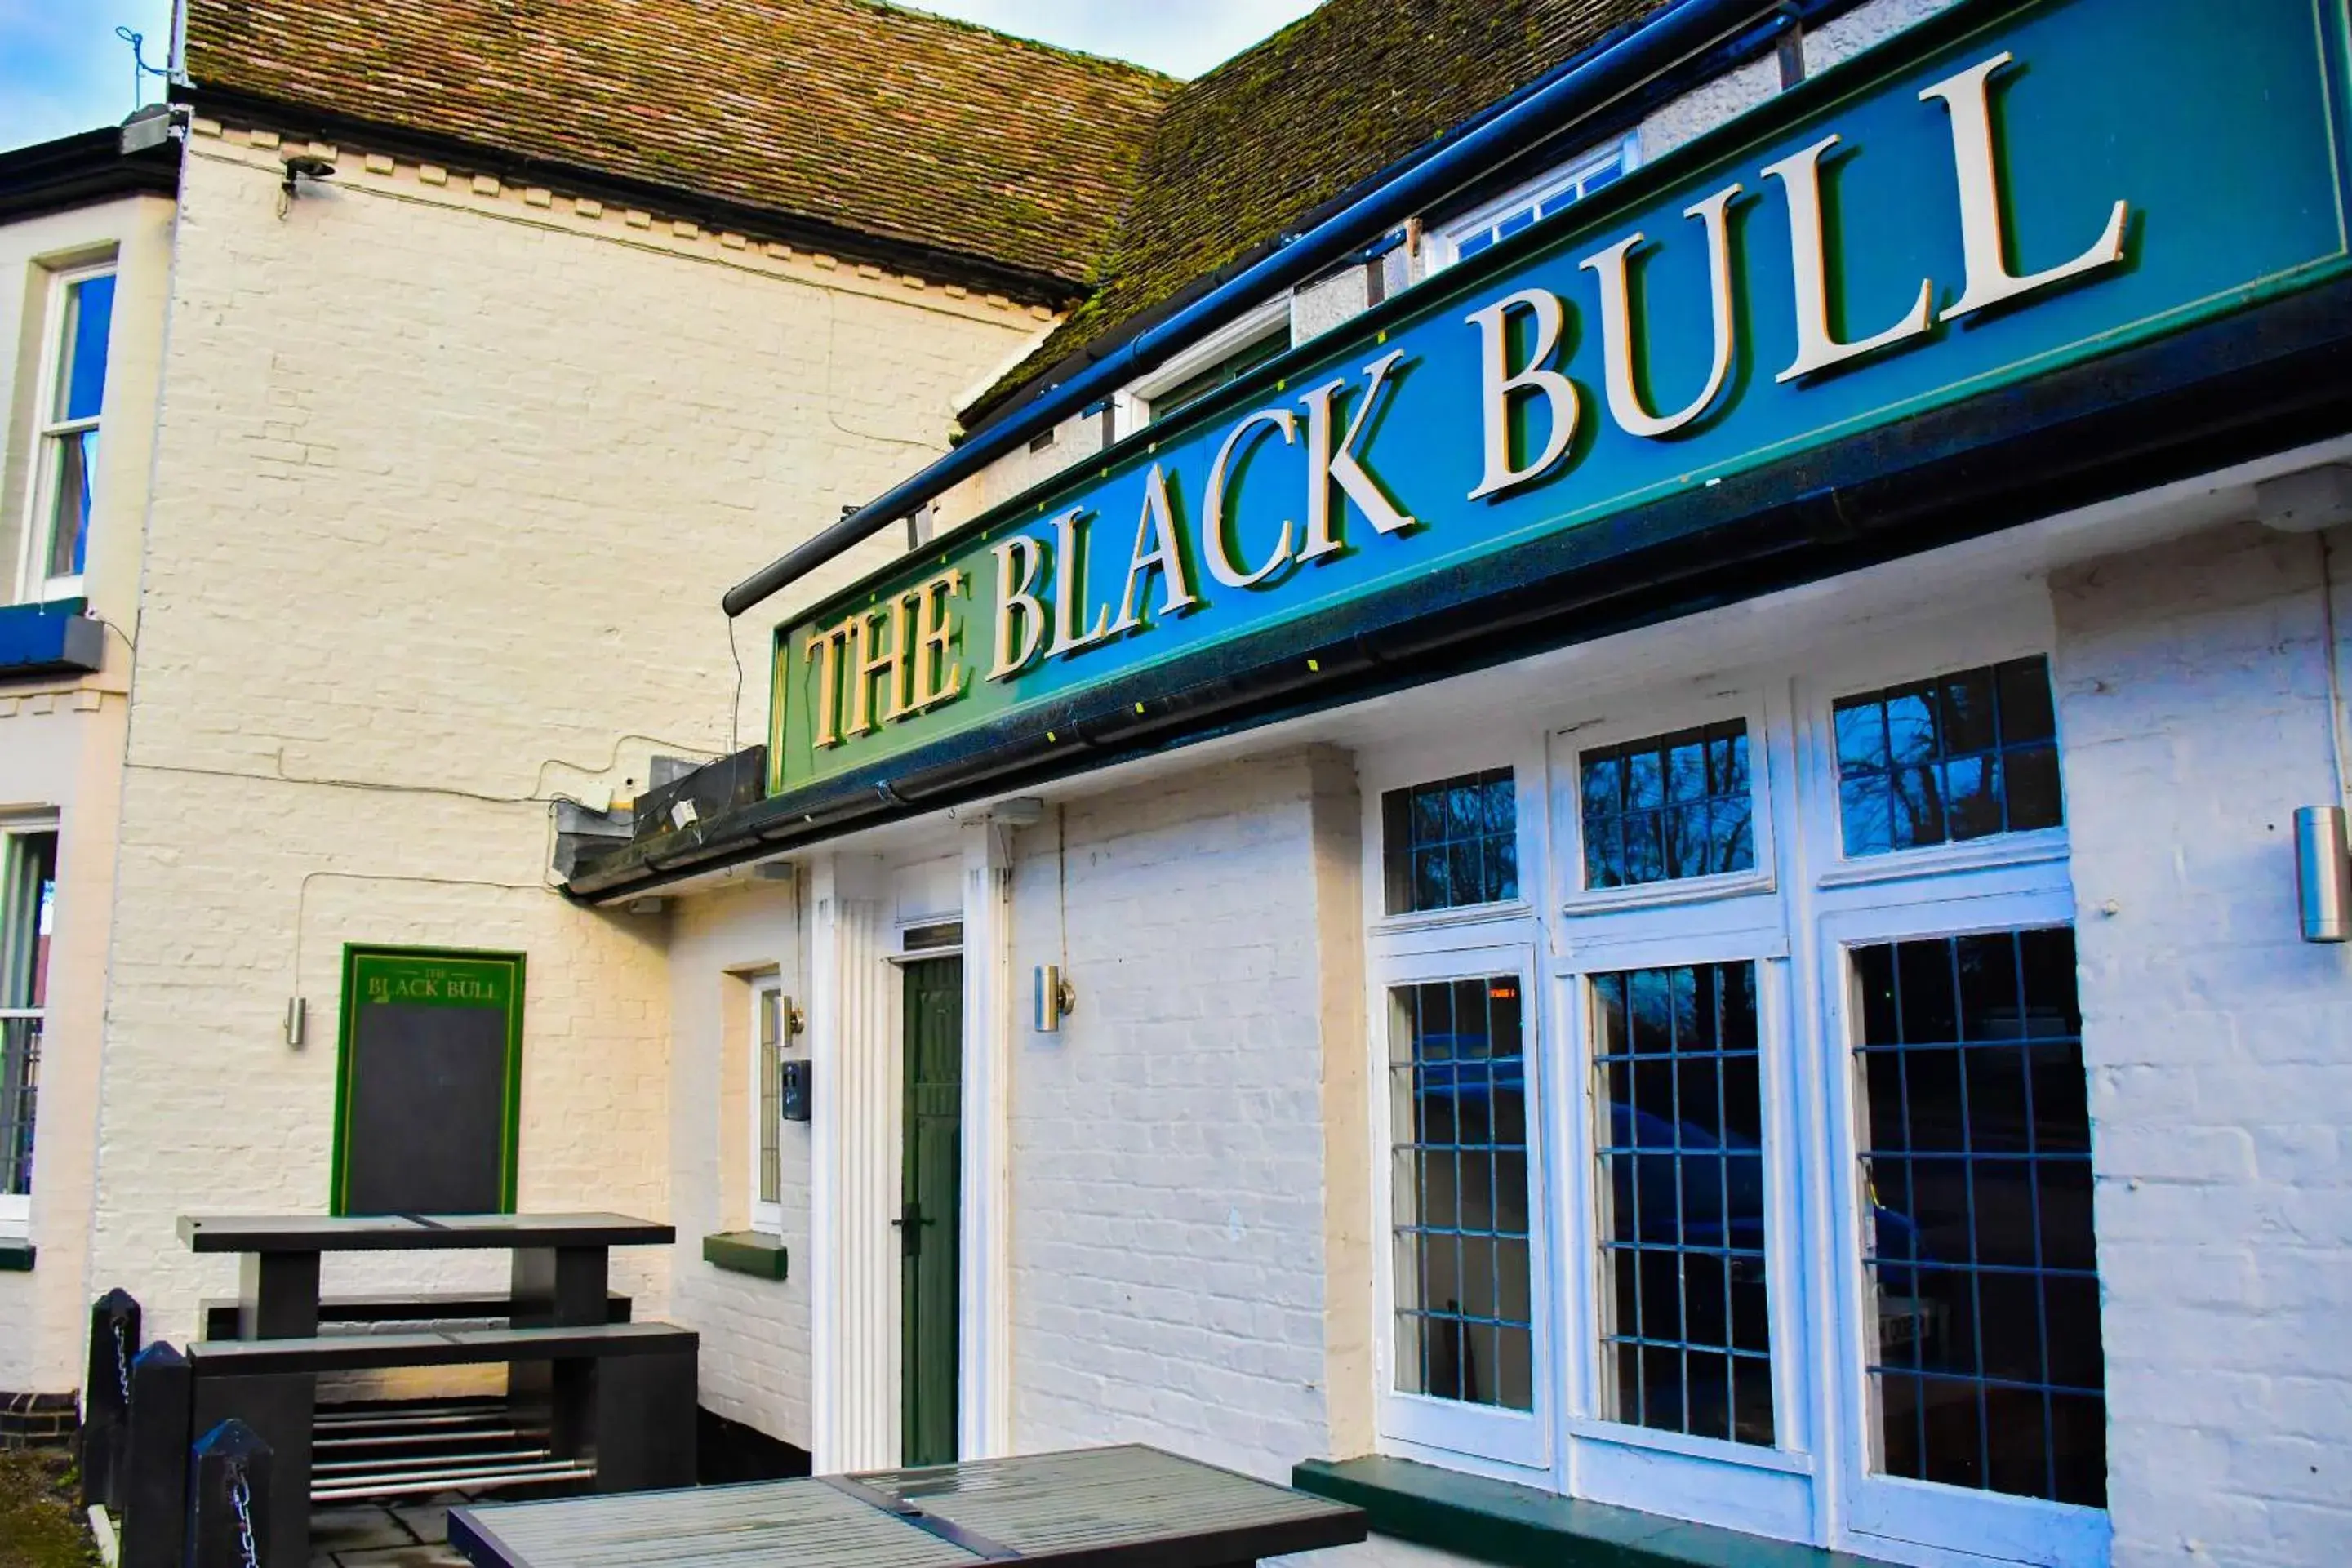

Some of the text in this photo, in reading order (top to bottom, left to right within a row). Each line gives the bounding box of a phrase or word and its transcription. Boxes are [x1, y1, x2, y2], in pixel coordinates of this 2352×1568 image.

[805, 51, 2127, 749] THE BLACK BULL
[369, 978, 500, 999] BLACK BULL
